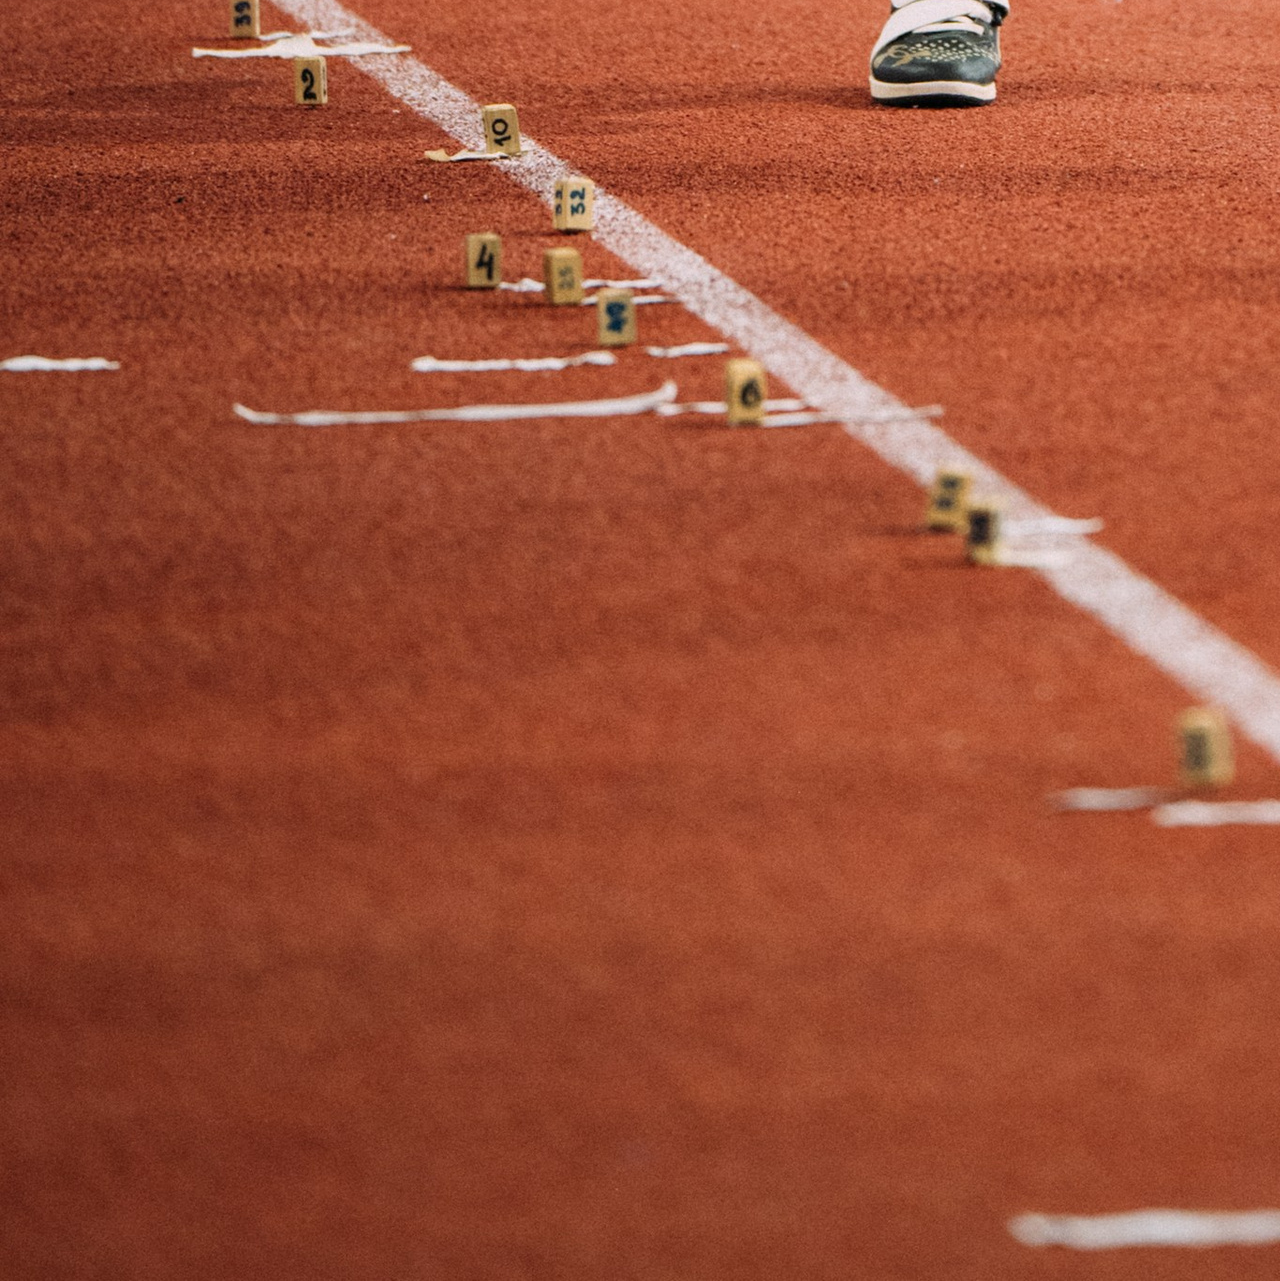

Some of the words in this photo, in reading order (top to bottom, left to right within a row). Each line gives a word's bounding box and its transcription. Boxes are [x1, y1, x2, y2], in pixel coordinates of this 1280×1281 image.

[301, 67, 319, 101] 2
[491, 117, 511, 147] 10
[570, 187, 587, 216] 32
[476, 243, 495, 281] 4
